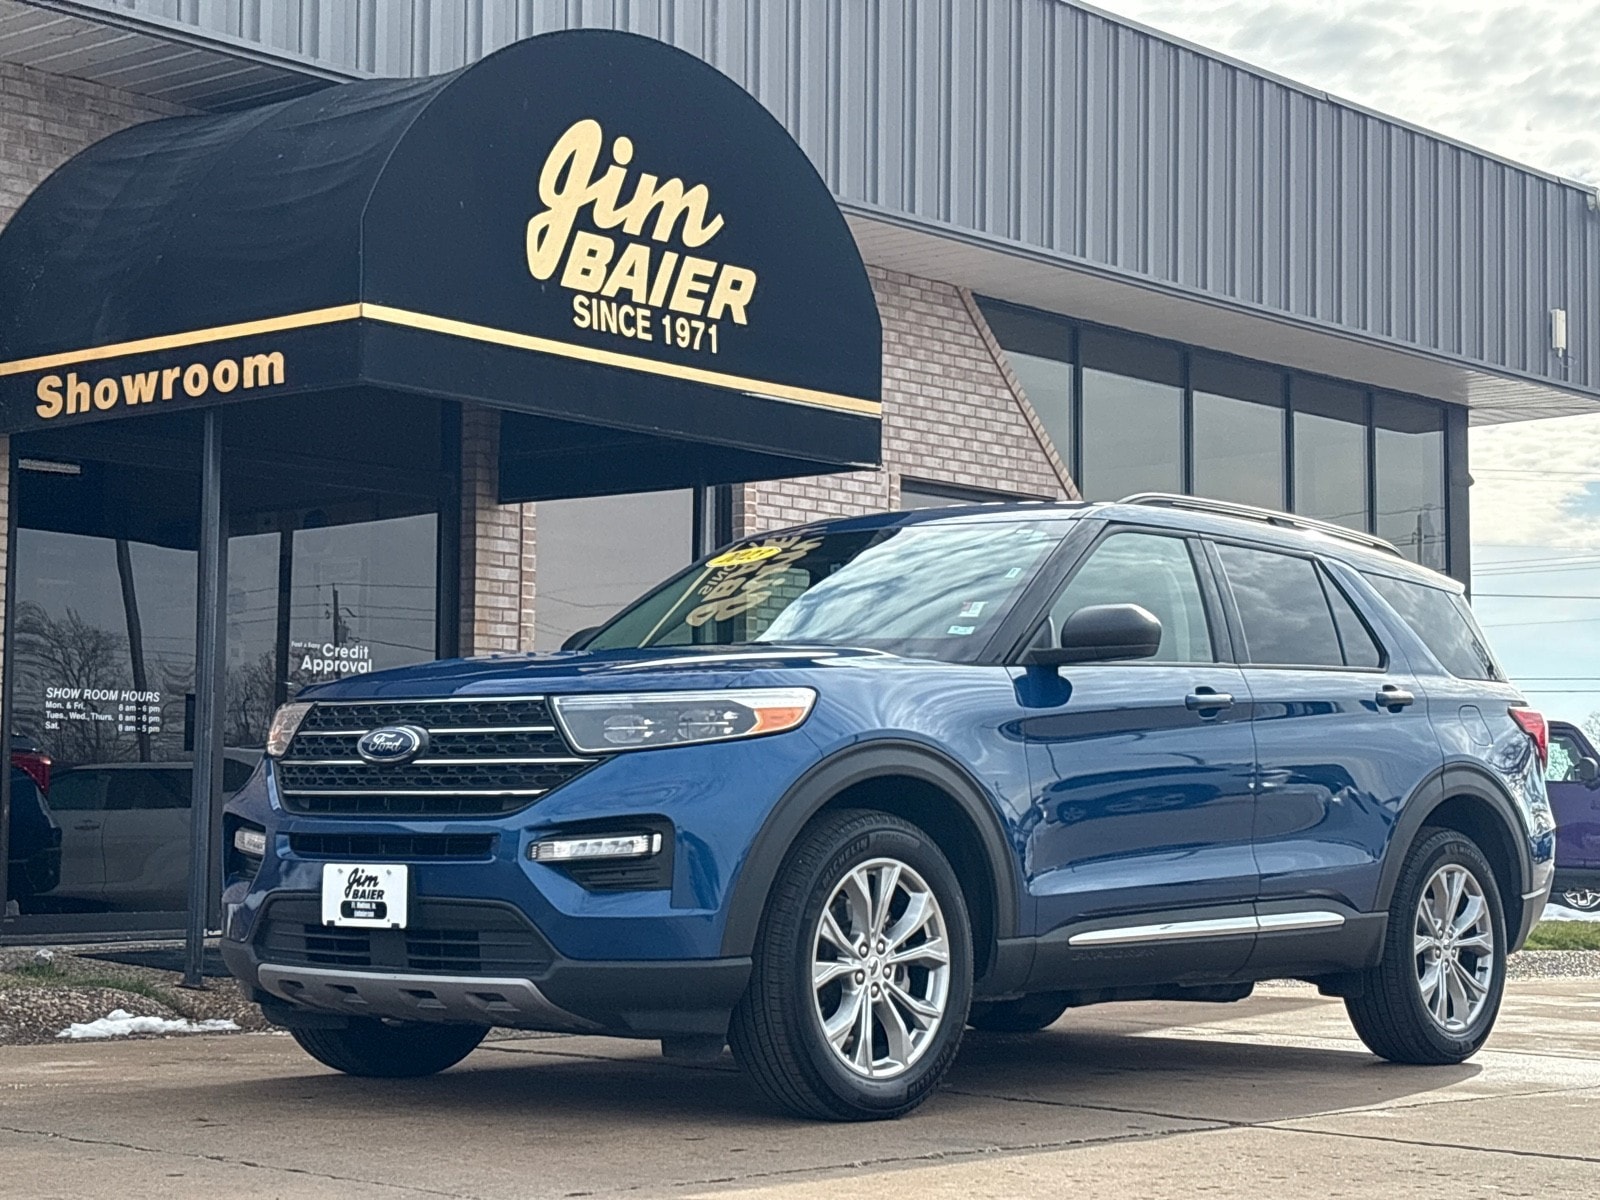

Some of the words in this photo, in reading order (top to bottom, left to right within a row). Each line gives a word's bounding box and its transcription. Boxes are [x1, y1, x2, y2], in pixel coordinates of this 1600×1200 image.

[527, 119, 725, 280] Jim
[560, 230, 757, 325] BAIER
[573, 295, 653, 341] SINCE
[662, 315, 718, 354] 1971
[36, 351, 285, 418] Showroom
[322, 643, 369, 659] Credit
[301, 655, 372, 674] Approval
[46, 687, 81, 699] SHOW
[83, 689, 118, 701] ROOM
[120, 690, 160, 703] HOURS
[45, 701, 64, 709] Mon.
[74, 702, 86, 710] Fri.
[118, 703, 124, 711] 8
[149, 706, 160, 714] pm
[45, 721, 60, 729] Sat.
[91, 713, 114, 721] Thurs.
[149, 716, 160, 724] pm
[149, 726, 160, 734] pm
[369, 733, 404, 752] Ford
[822, 836, 869, 888] MICHELIN
[344, 867, 379, 899] Jim
[352, 889, 385, 900] BAIER
